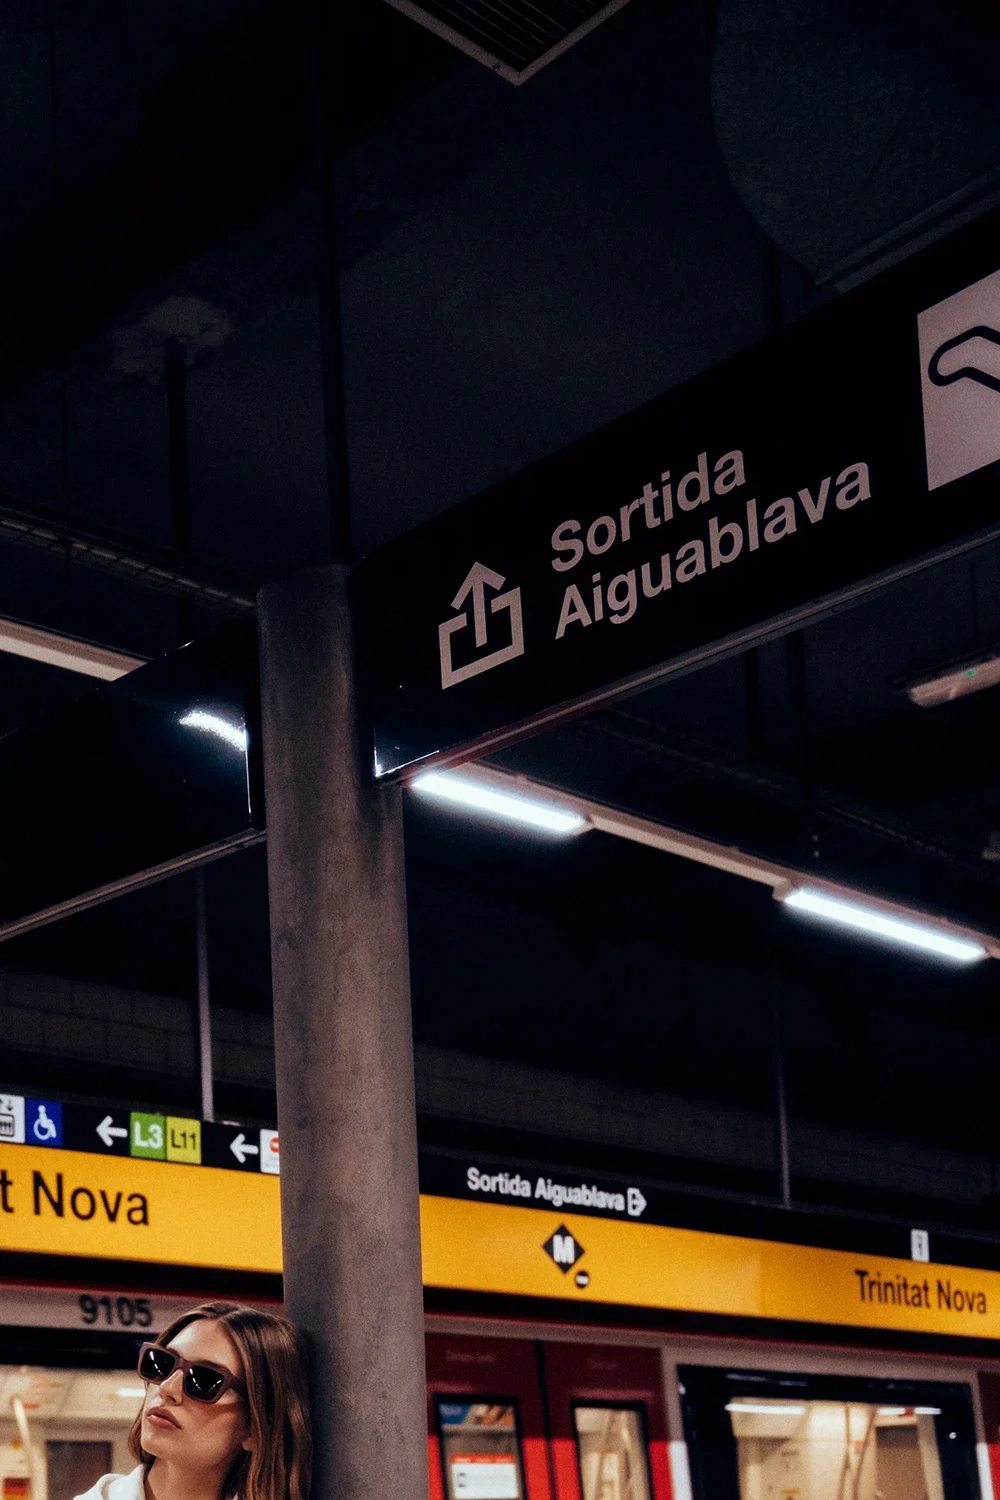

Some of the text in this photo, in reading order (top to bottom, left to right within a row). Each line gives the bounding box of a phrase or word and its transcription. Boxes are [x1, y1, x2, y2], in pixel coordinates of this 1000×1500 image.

[551, 449, 746, 573] Sortida
[555, 461, 872, 640] Aiguablava
[133, 1121, 197, 1151] L3 L11
[32, 1170, 149, 1227] Nova
[467, 1166, 626, 1211] Sortida Aiguablava
[552, 1234, 576, 1265] M
[79, 1294, 153, 1328] 9105
[854, 1268, 987, 1315] Trinitat Nova
